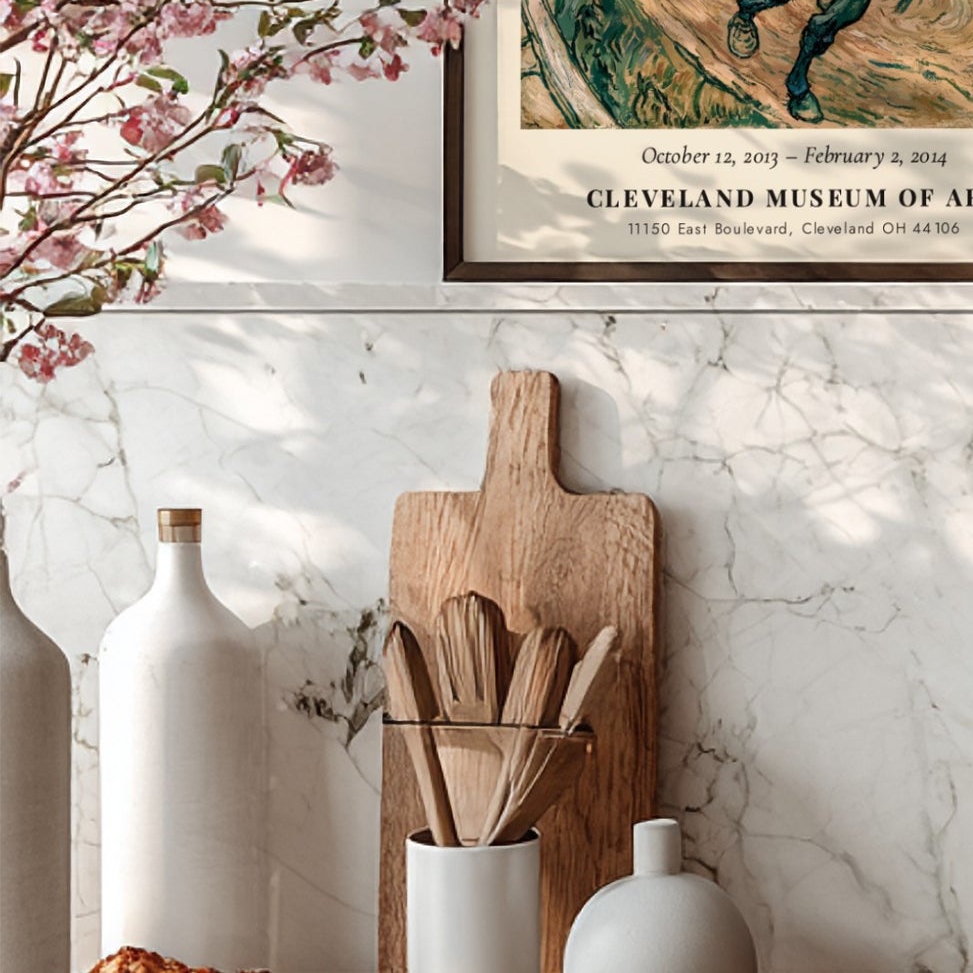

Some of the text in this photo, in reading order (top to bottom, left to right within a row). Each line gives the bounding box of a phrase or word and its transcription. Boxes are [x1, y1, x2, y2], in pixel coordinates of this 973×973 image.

[641, 144, 711, 165] October
[714, 151, 737, 168] 12,
[742, 151, 779, 171] 2013
[803, 143, 885, 170] February
[890, 151, 904, 167] 2,
[909, 151, 948, 168] 2014
[586, 188, 754, 208] CLEVELAND
[765, 188, 887, 208] MUSEUM
[898, 187, 934, 208] OF
[627, 220, 961, 237] 11150 East Boulevard, Cleveland OH 44106
